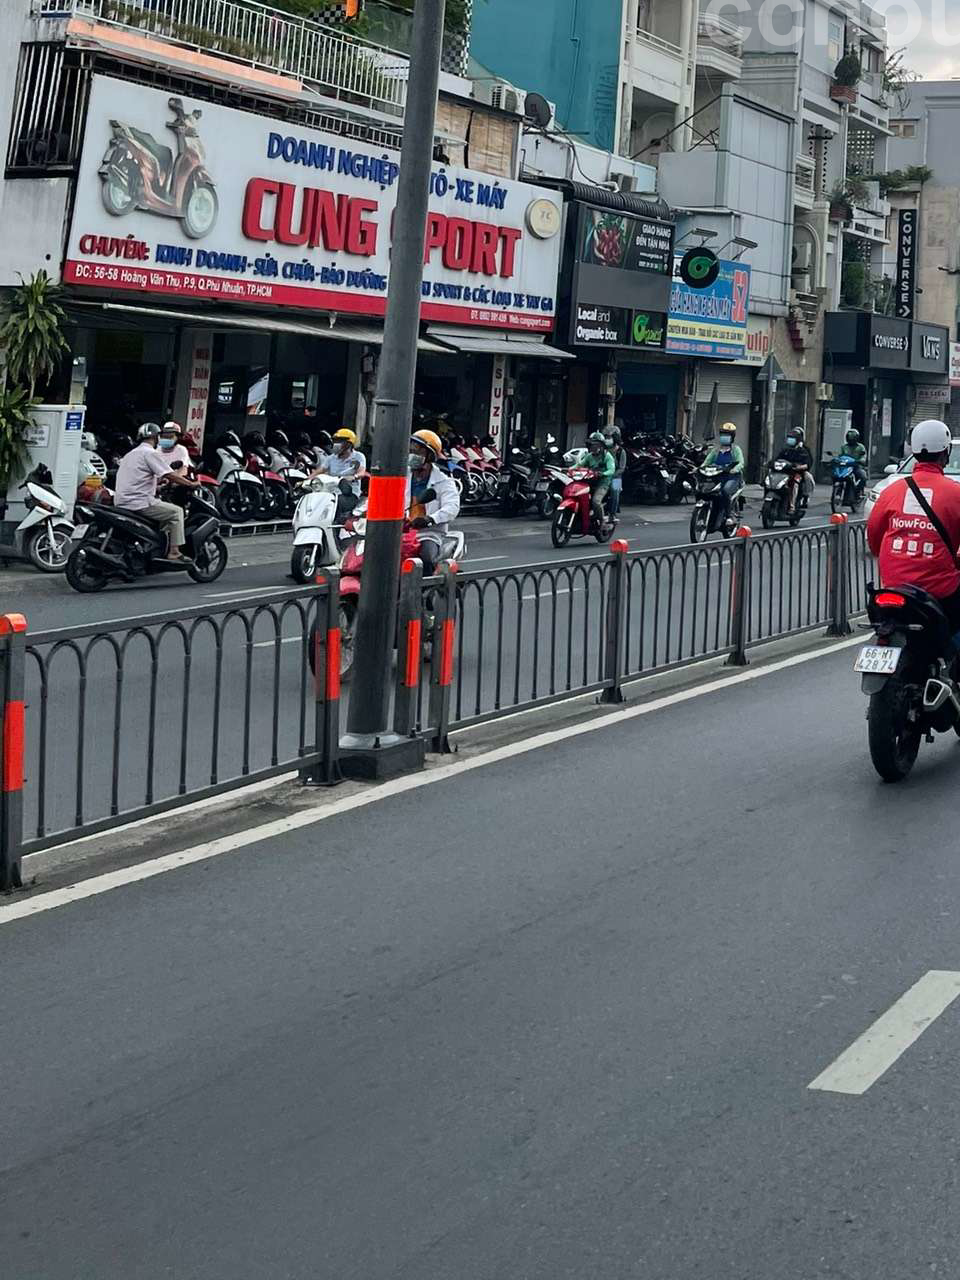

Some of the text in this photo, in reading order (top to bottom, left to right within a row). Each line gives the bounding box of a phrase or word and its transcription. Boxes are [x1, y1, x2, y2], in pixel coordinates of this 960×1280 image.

[267, 132, 336, 172] DOANH
[338, 151, 400, 191] NGHIỆP
[477, 182, 508, 210] MÁY
[242, 176, 522, 279] CUNG PORT
[155, 244, 193, 265] KINH
[901, 211, 912, 303] CONVERSE
[94, 267, 118, 281] 56-58
[577, 307, 611, 322] Local and
[576, 325, 618, 341] Organic box
[747, 330, 768, 357] ulip
[874, 334, 904, 350] CONVERSE
[922, 335, 941, 360] VANS
